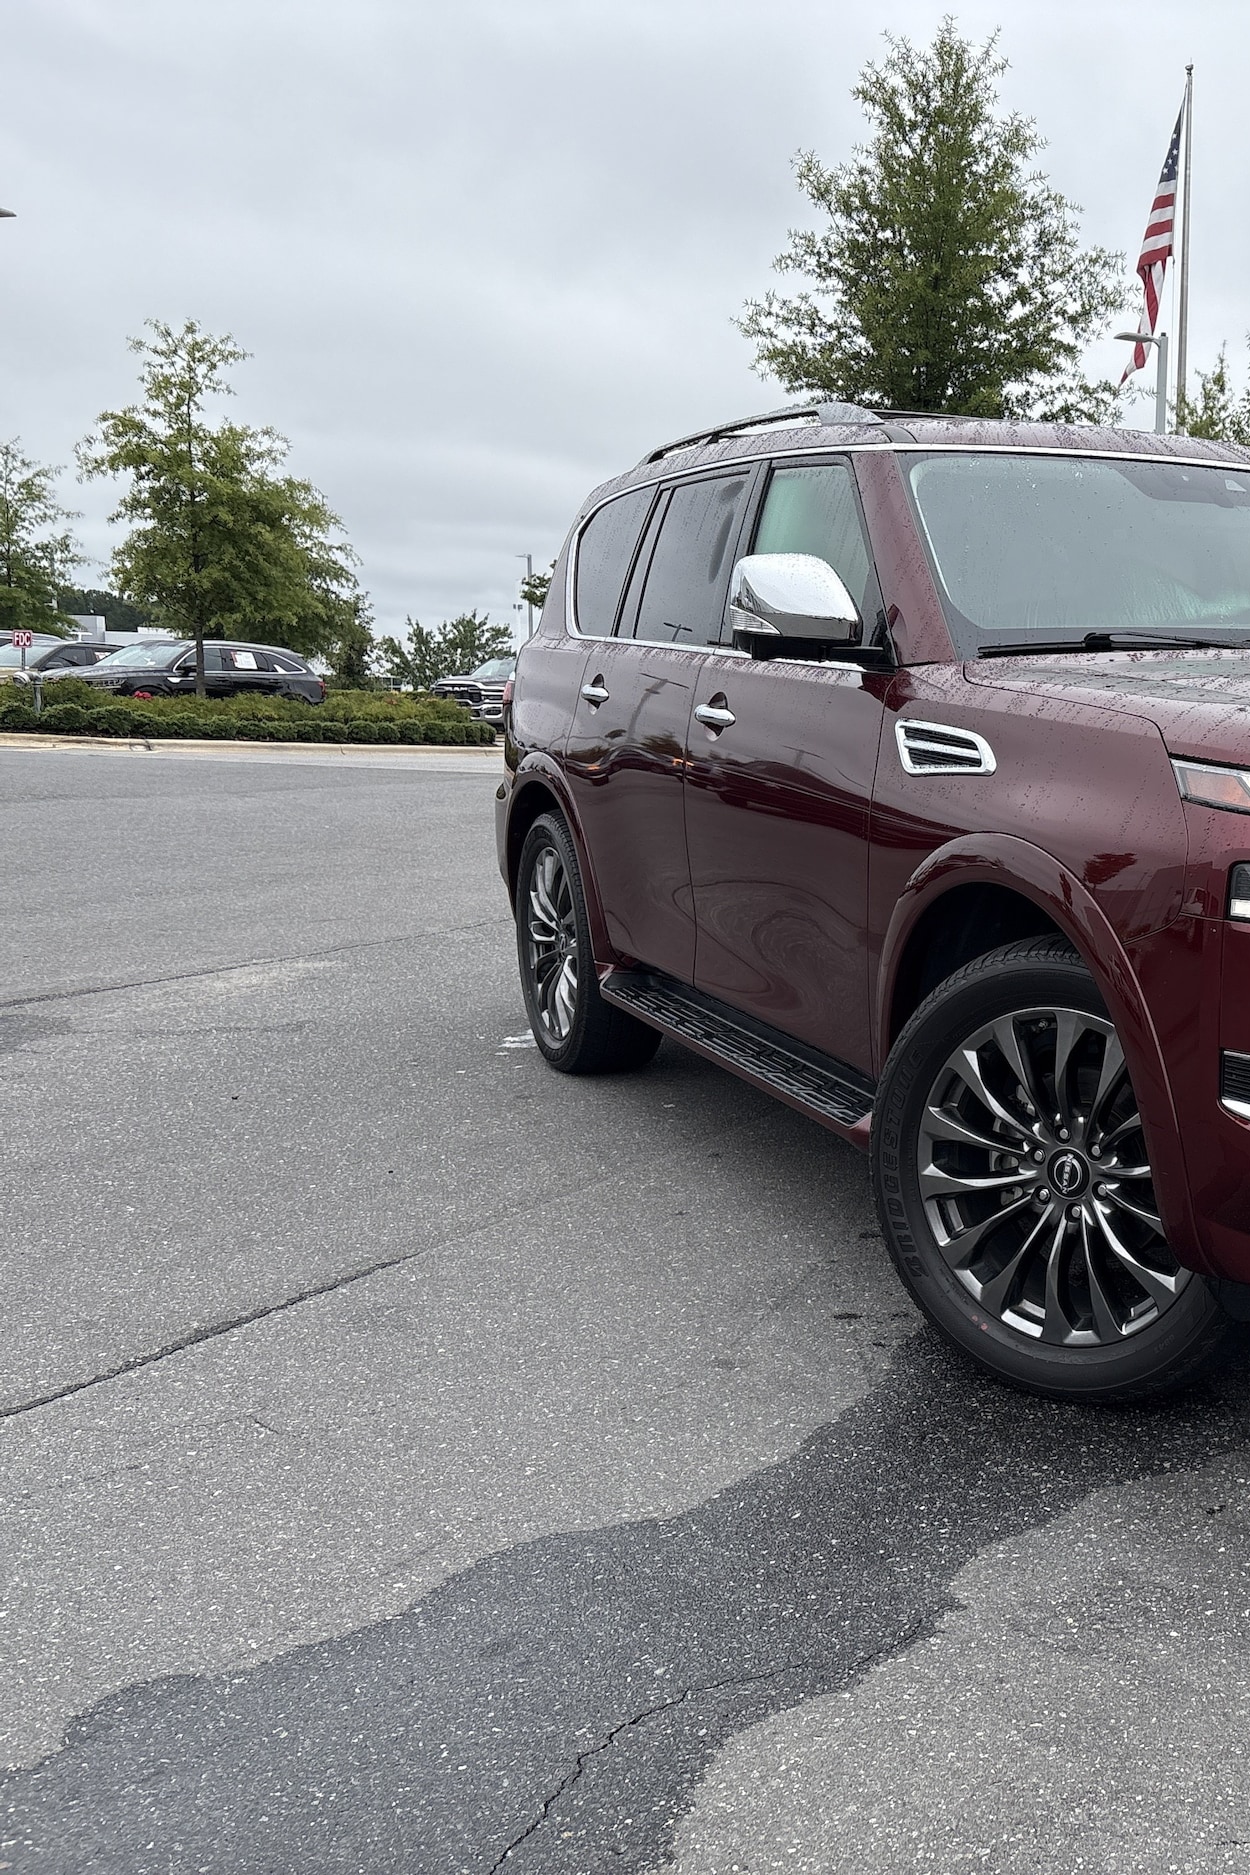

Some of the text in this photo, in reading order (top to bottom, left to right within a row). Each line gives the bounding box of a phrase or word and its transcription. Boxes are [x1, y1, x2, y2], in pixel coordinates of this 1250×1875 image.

[14, 632, 30, 646] FDC
[882, 1048, 929, 1278] BRIDGESTONE
[1062, 1153, 1074, 1194] NISSAN
